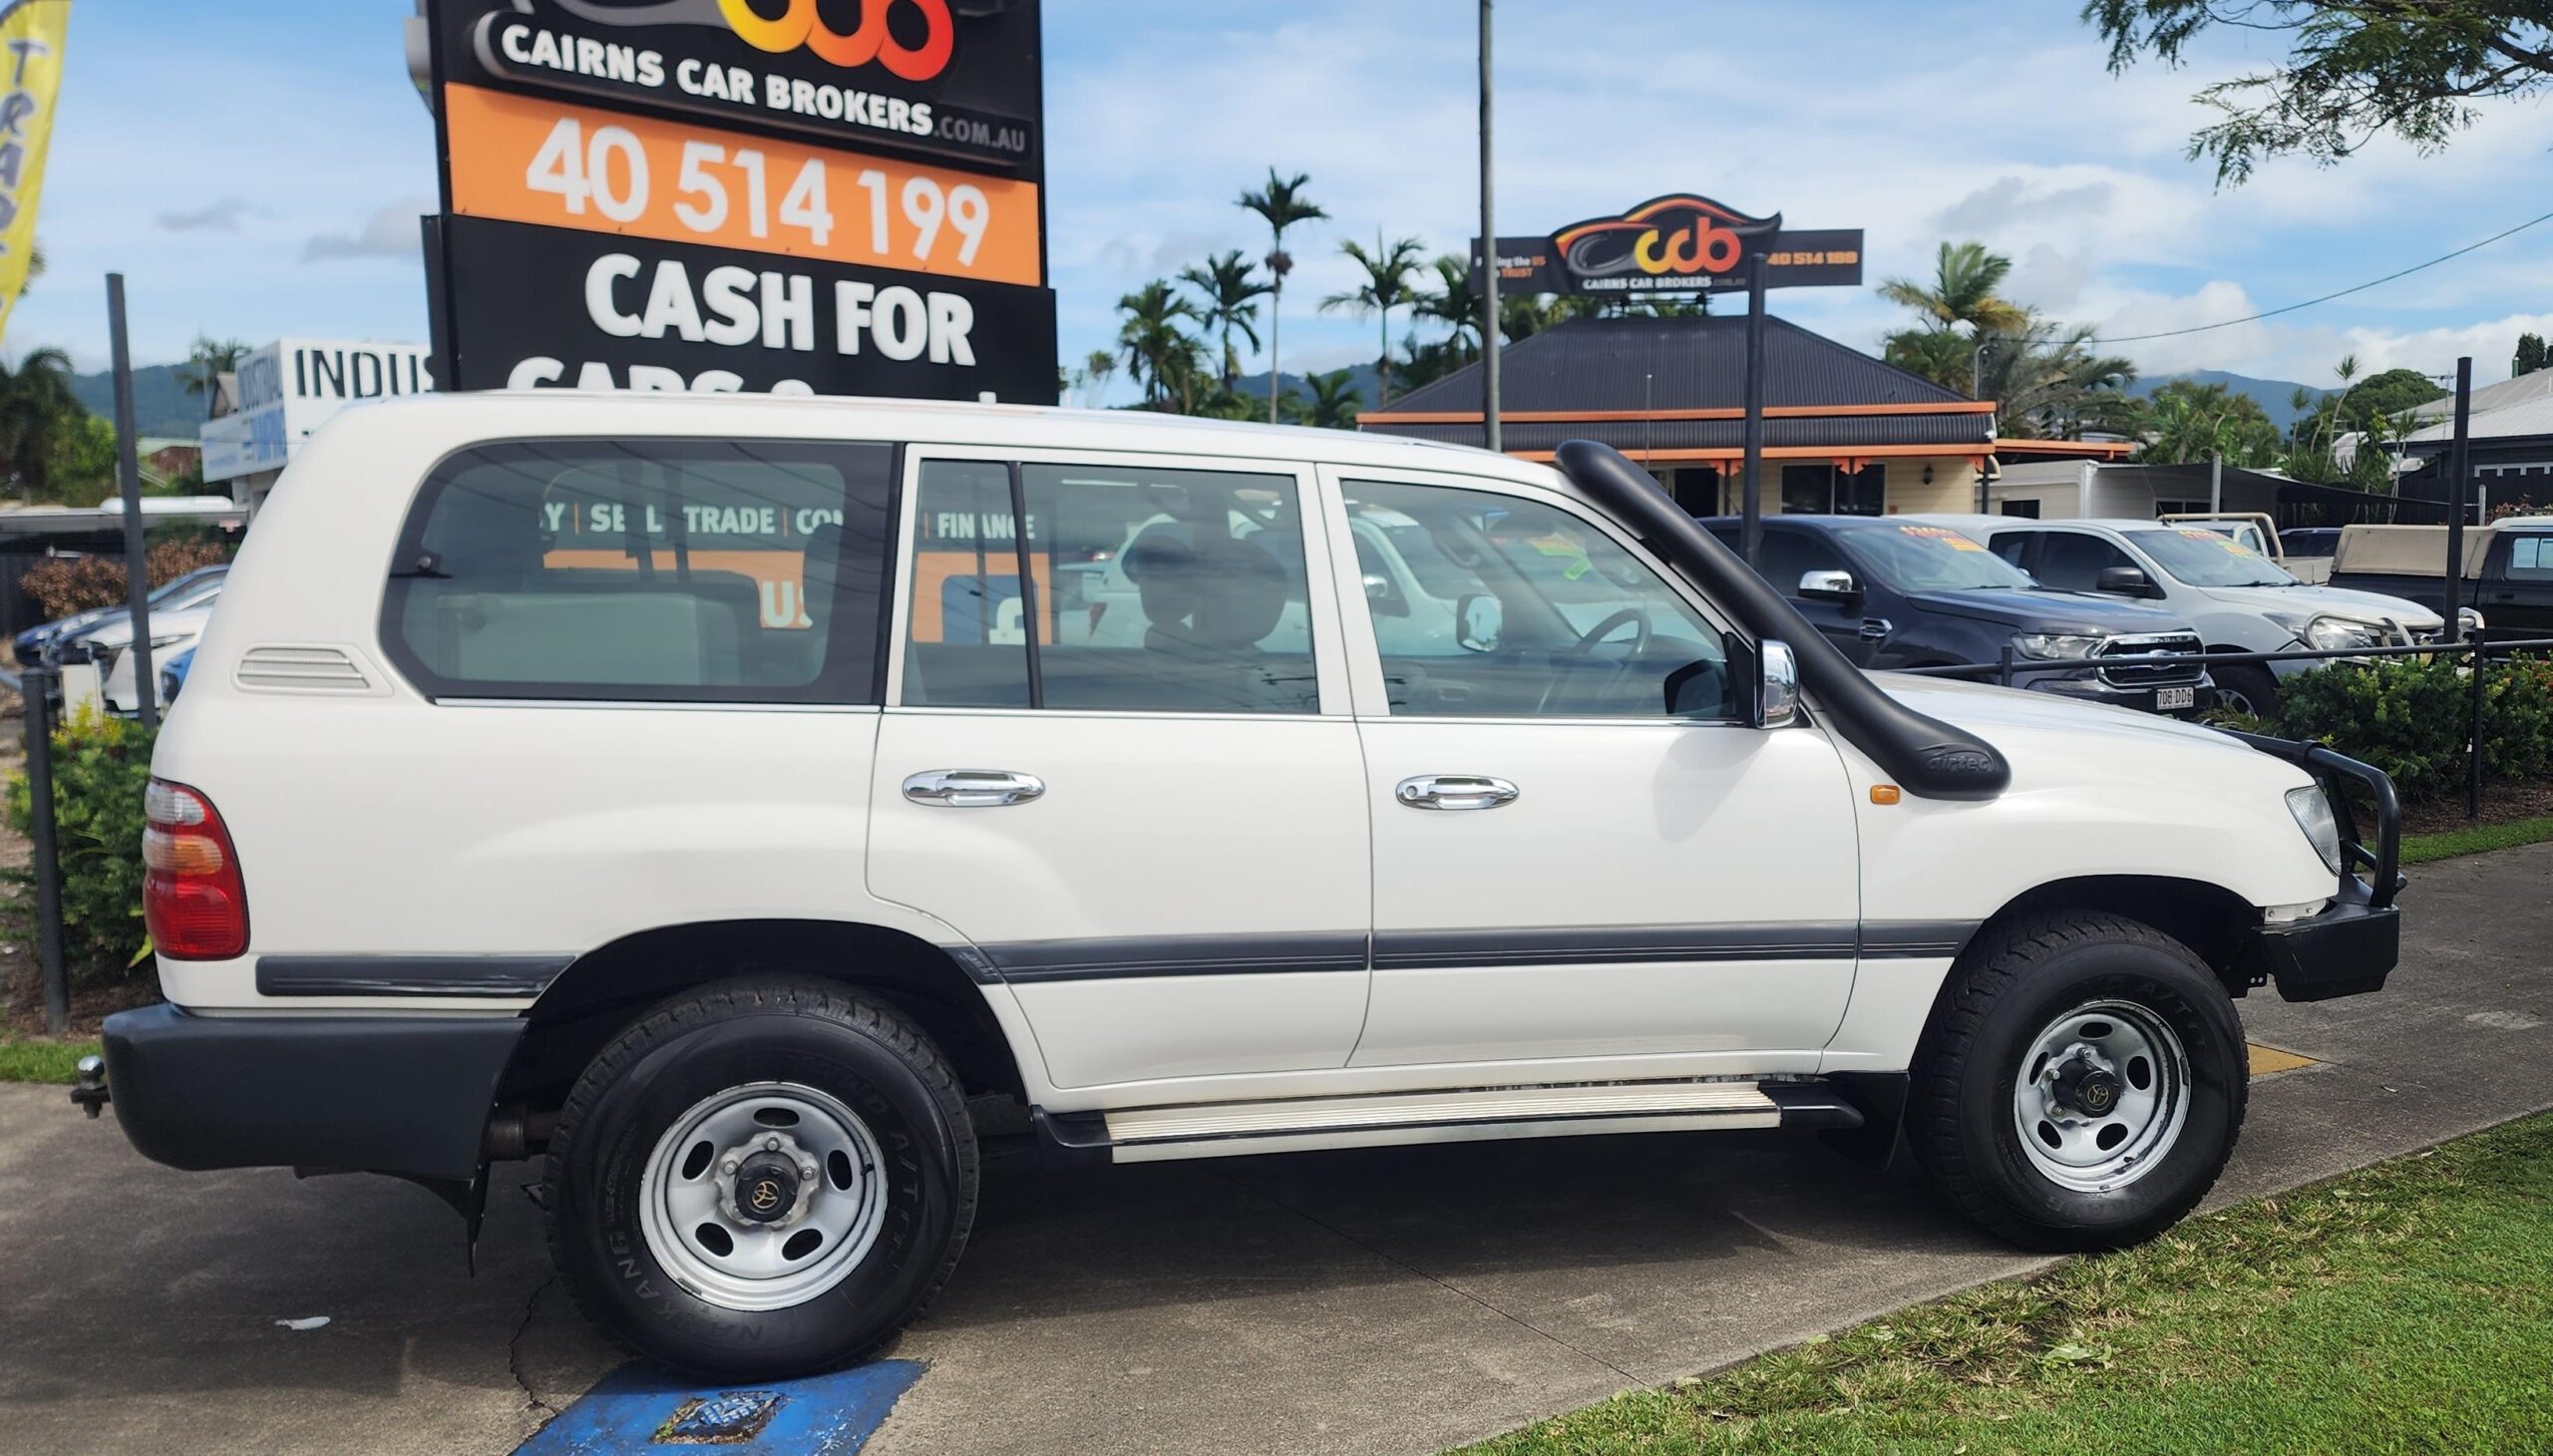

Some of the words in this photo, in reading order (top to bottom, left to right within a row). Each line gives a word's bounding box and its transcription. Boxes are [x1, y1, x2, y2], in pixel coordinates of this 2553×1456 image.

[502, 24, 665, 89] CAIRNS
[676, 60, 756, 106] CAR
[765, 75, 932, 138] BROKERS
[526, 118, 650, 223] 40
[672, 140, 834, 247] 514
[857, 170, 990, 267] 199
[584, 252, 815, 352] CASH
[835, 279, 976, 367] FOR
[1582, 277, 1628, 290] CAIRNS
[1629, 277, 1653, 289] CAR
[1654, 275, 1712, 289] BROKERS
[590, 504, 663, 535] SEL
[682, 506, 776, 536] TRADE
